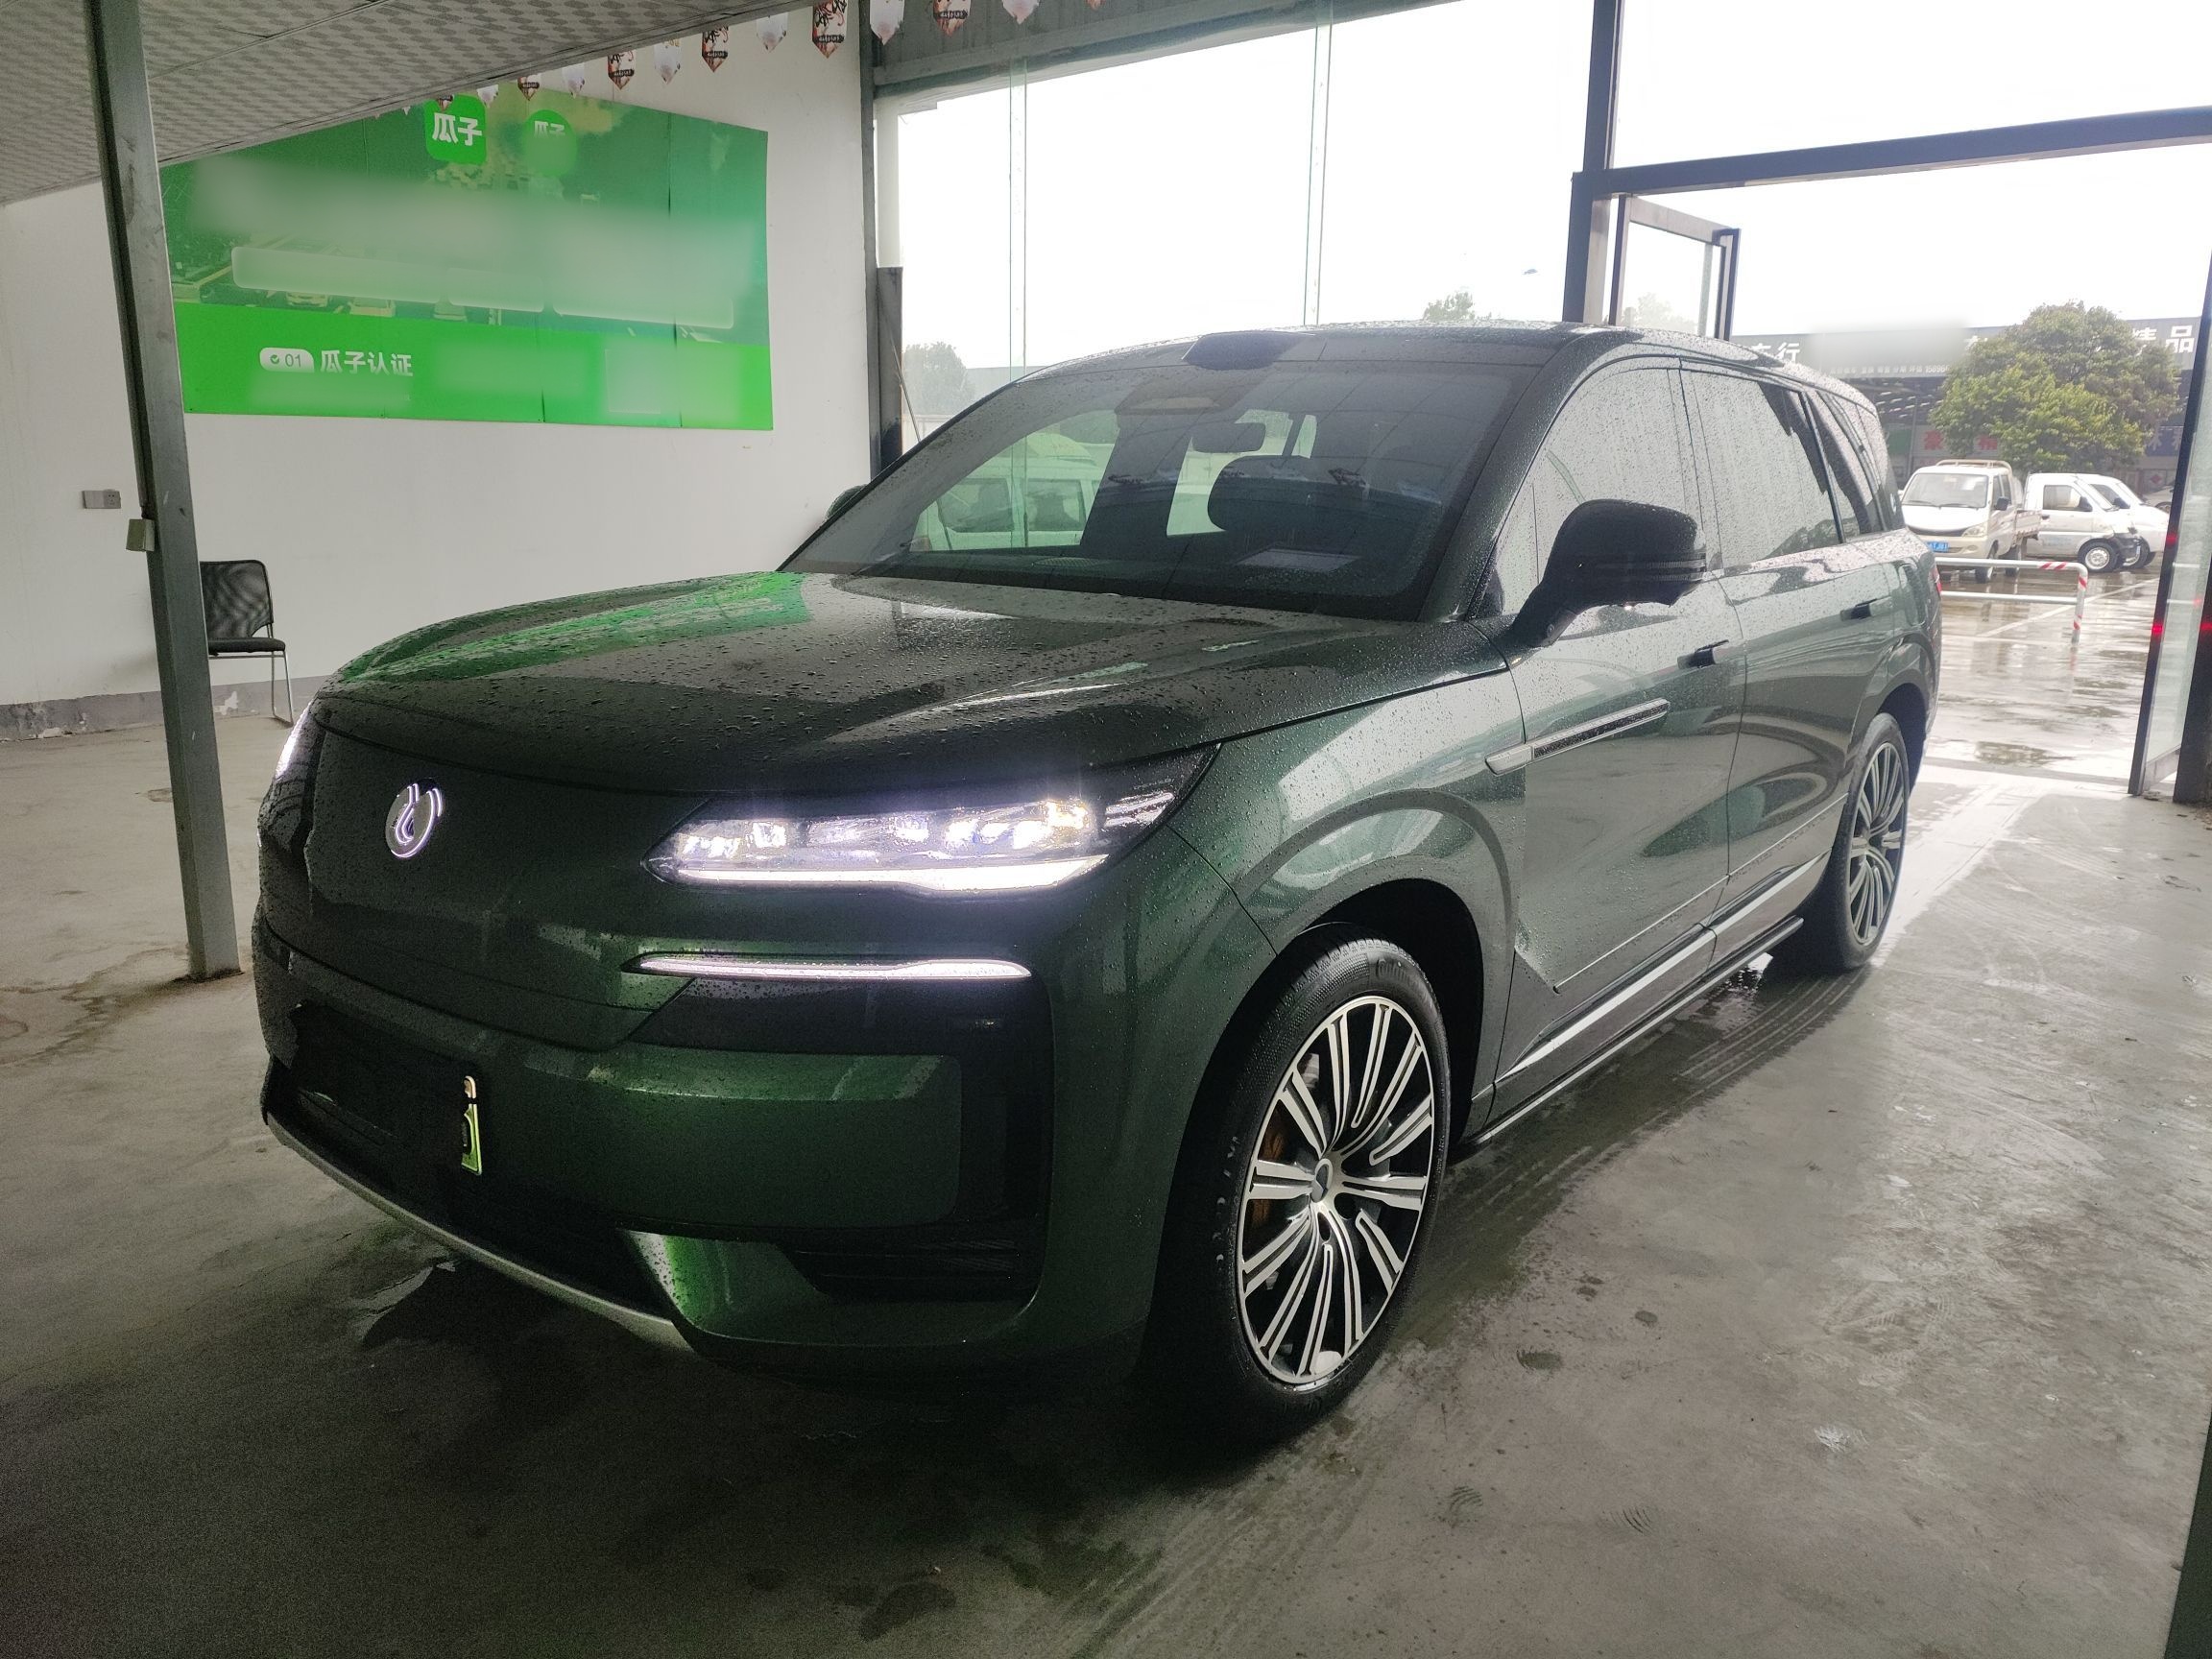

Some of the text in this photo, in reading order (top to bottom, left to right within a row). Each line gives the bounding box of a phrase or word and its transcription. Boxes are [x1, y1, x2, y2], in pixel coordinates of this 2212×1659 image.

[432, 112, 483, 146] 瓜子
[285, 353, 302, 368] 01
[320, 349, 414, 377] 瓜子认证
